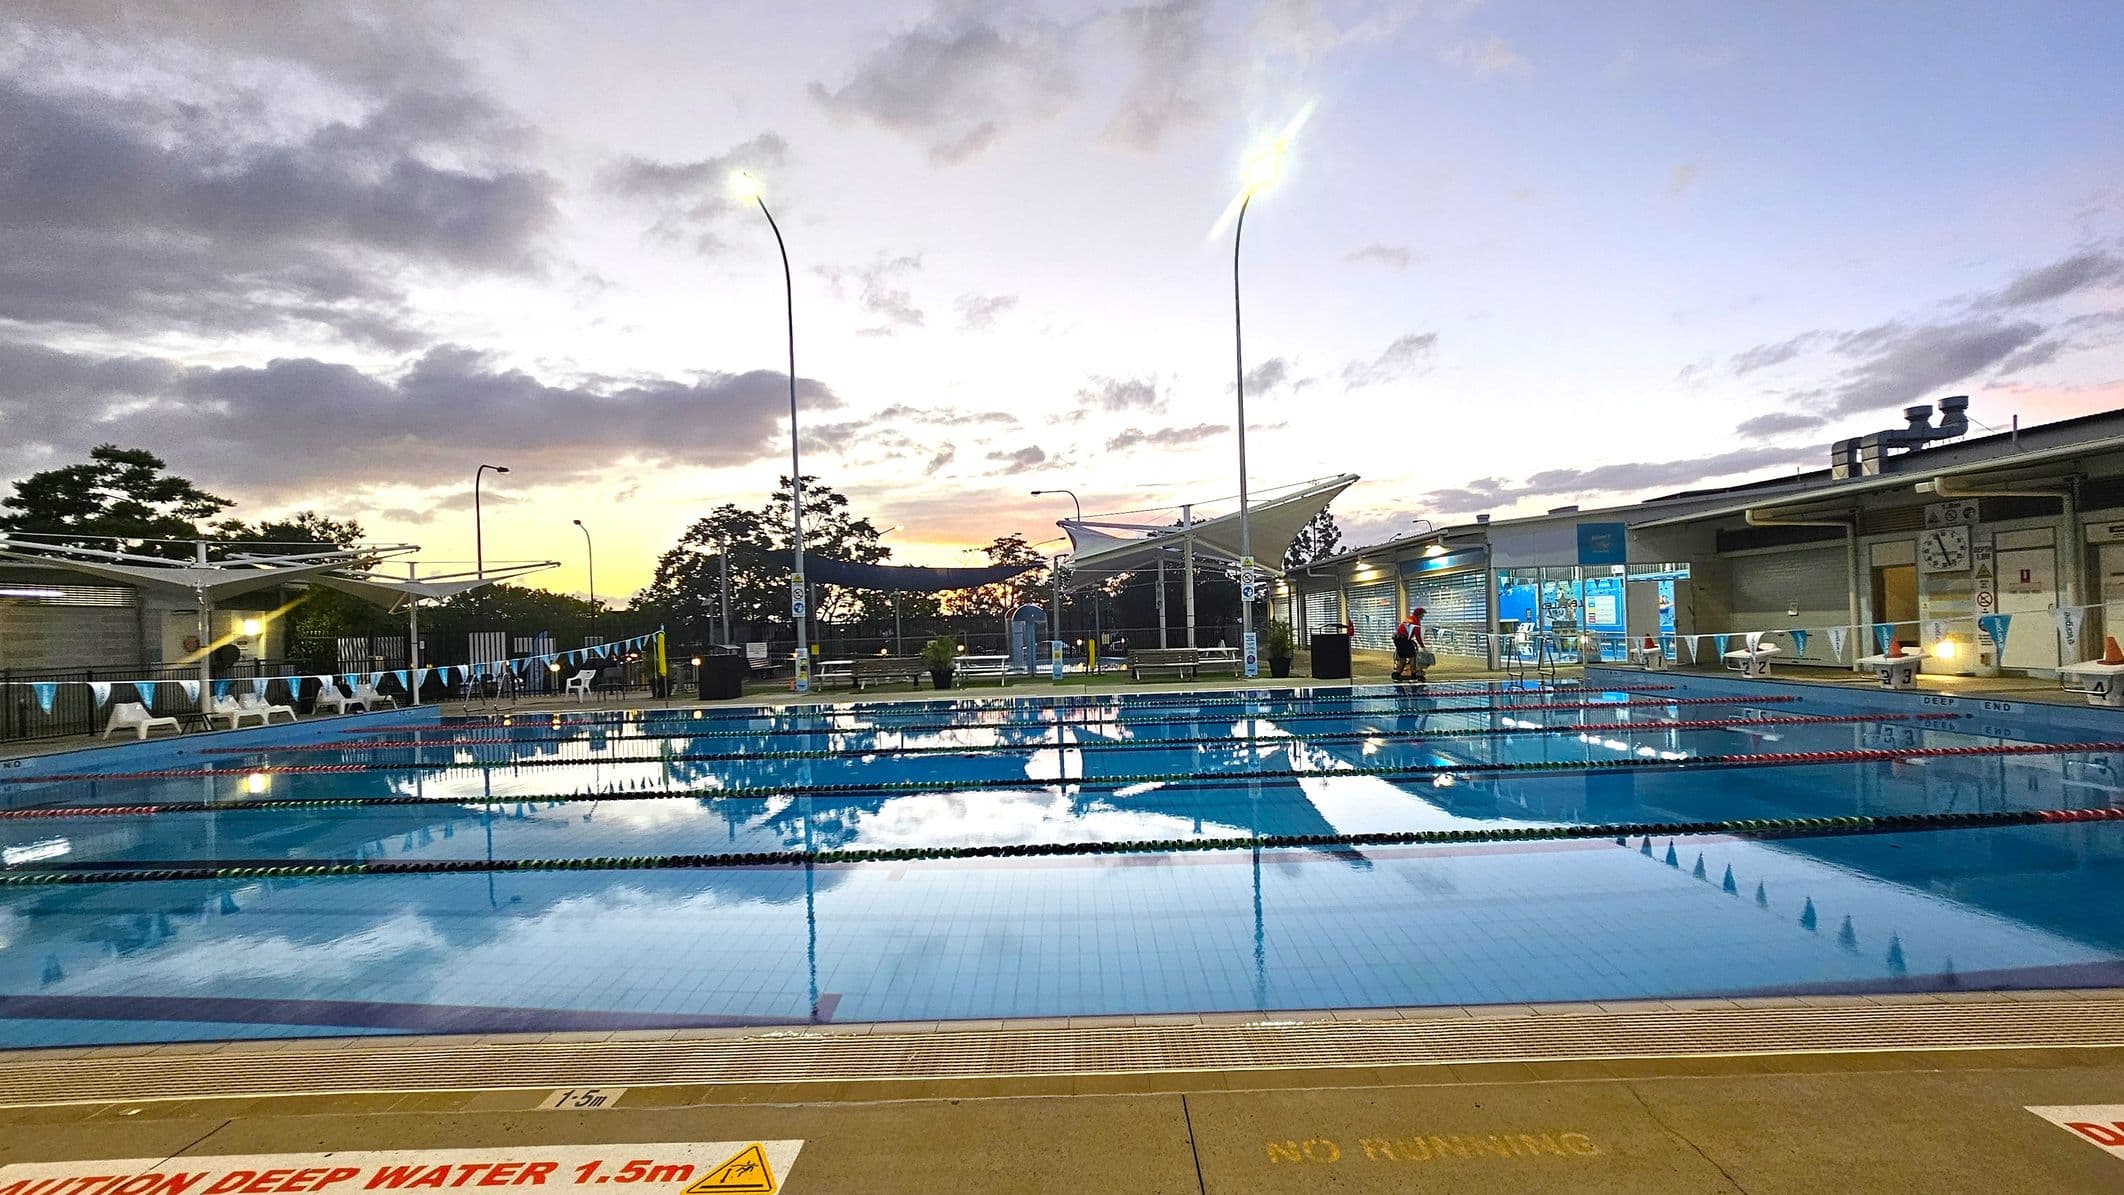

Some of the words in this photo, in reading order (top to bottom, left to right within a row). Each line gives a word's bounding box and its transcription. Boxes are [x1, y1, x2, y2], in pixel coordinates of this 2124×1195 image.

[1758, 661, 1766, 675] 2
[1903, 668, 1912, 684] 3
[2091, 681, 2107, 700] 4
[1923, 696, 1955, 706] DEEP
[1984, 701, 2012, 712] END
[1266, 1138, 1341, 1163] NO
[1357, 1132, 1602, 1162] RUNNING
[201, 1167, 361, 1195] DEEP
[363, 1160, 559, 1190] WATER
[574, 1159, 696, 1185] 1.5m
